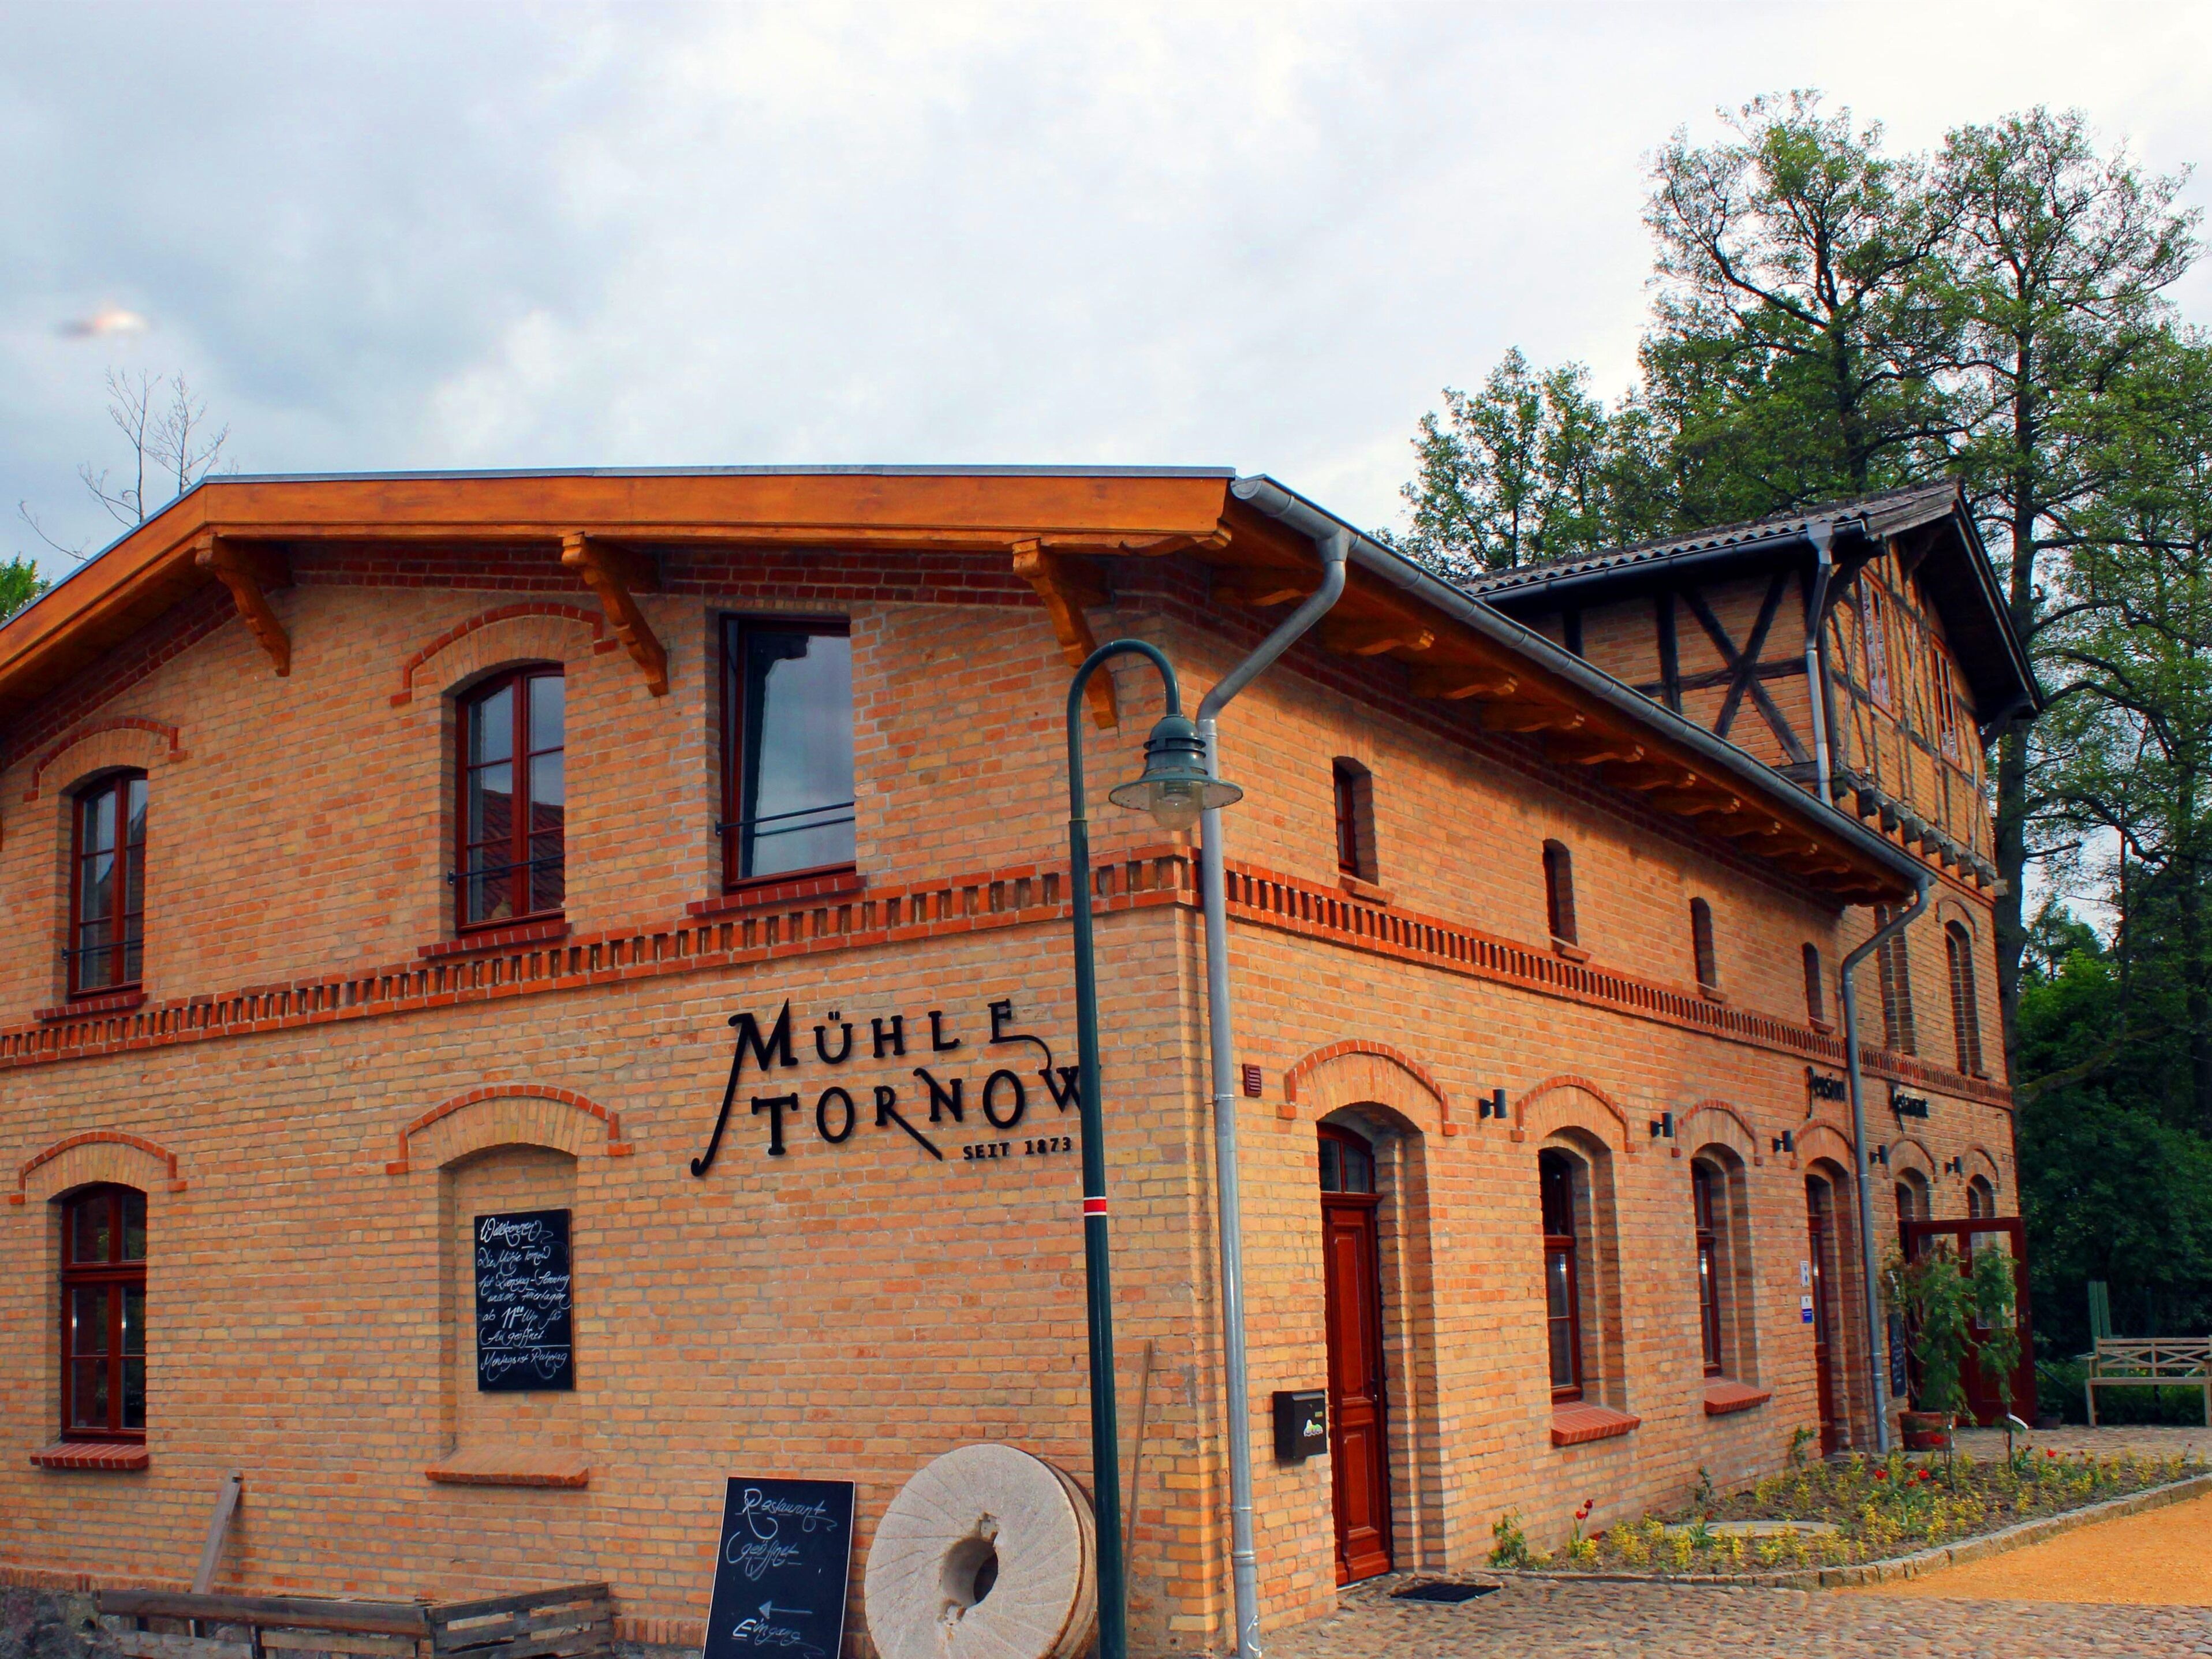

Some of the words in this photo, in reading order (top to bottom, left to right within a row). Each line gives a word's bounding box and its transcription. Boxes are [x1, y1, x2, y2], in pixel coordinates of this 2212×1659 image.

[751, 1067, 1101, 1161] TORNOW
[963, 1144, 1010, 1160] SEIT
[1024, 1137, 1072, 1154] 1873
[483, 1309, 496, 1321] ab
[742, 1488, 827, 1540] Restaurant
